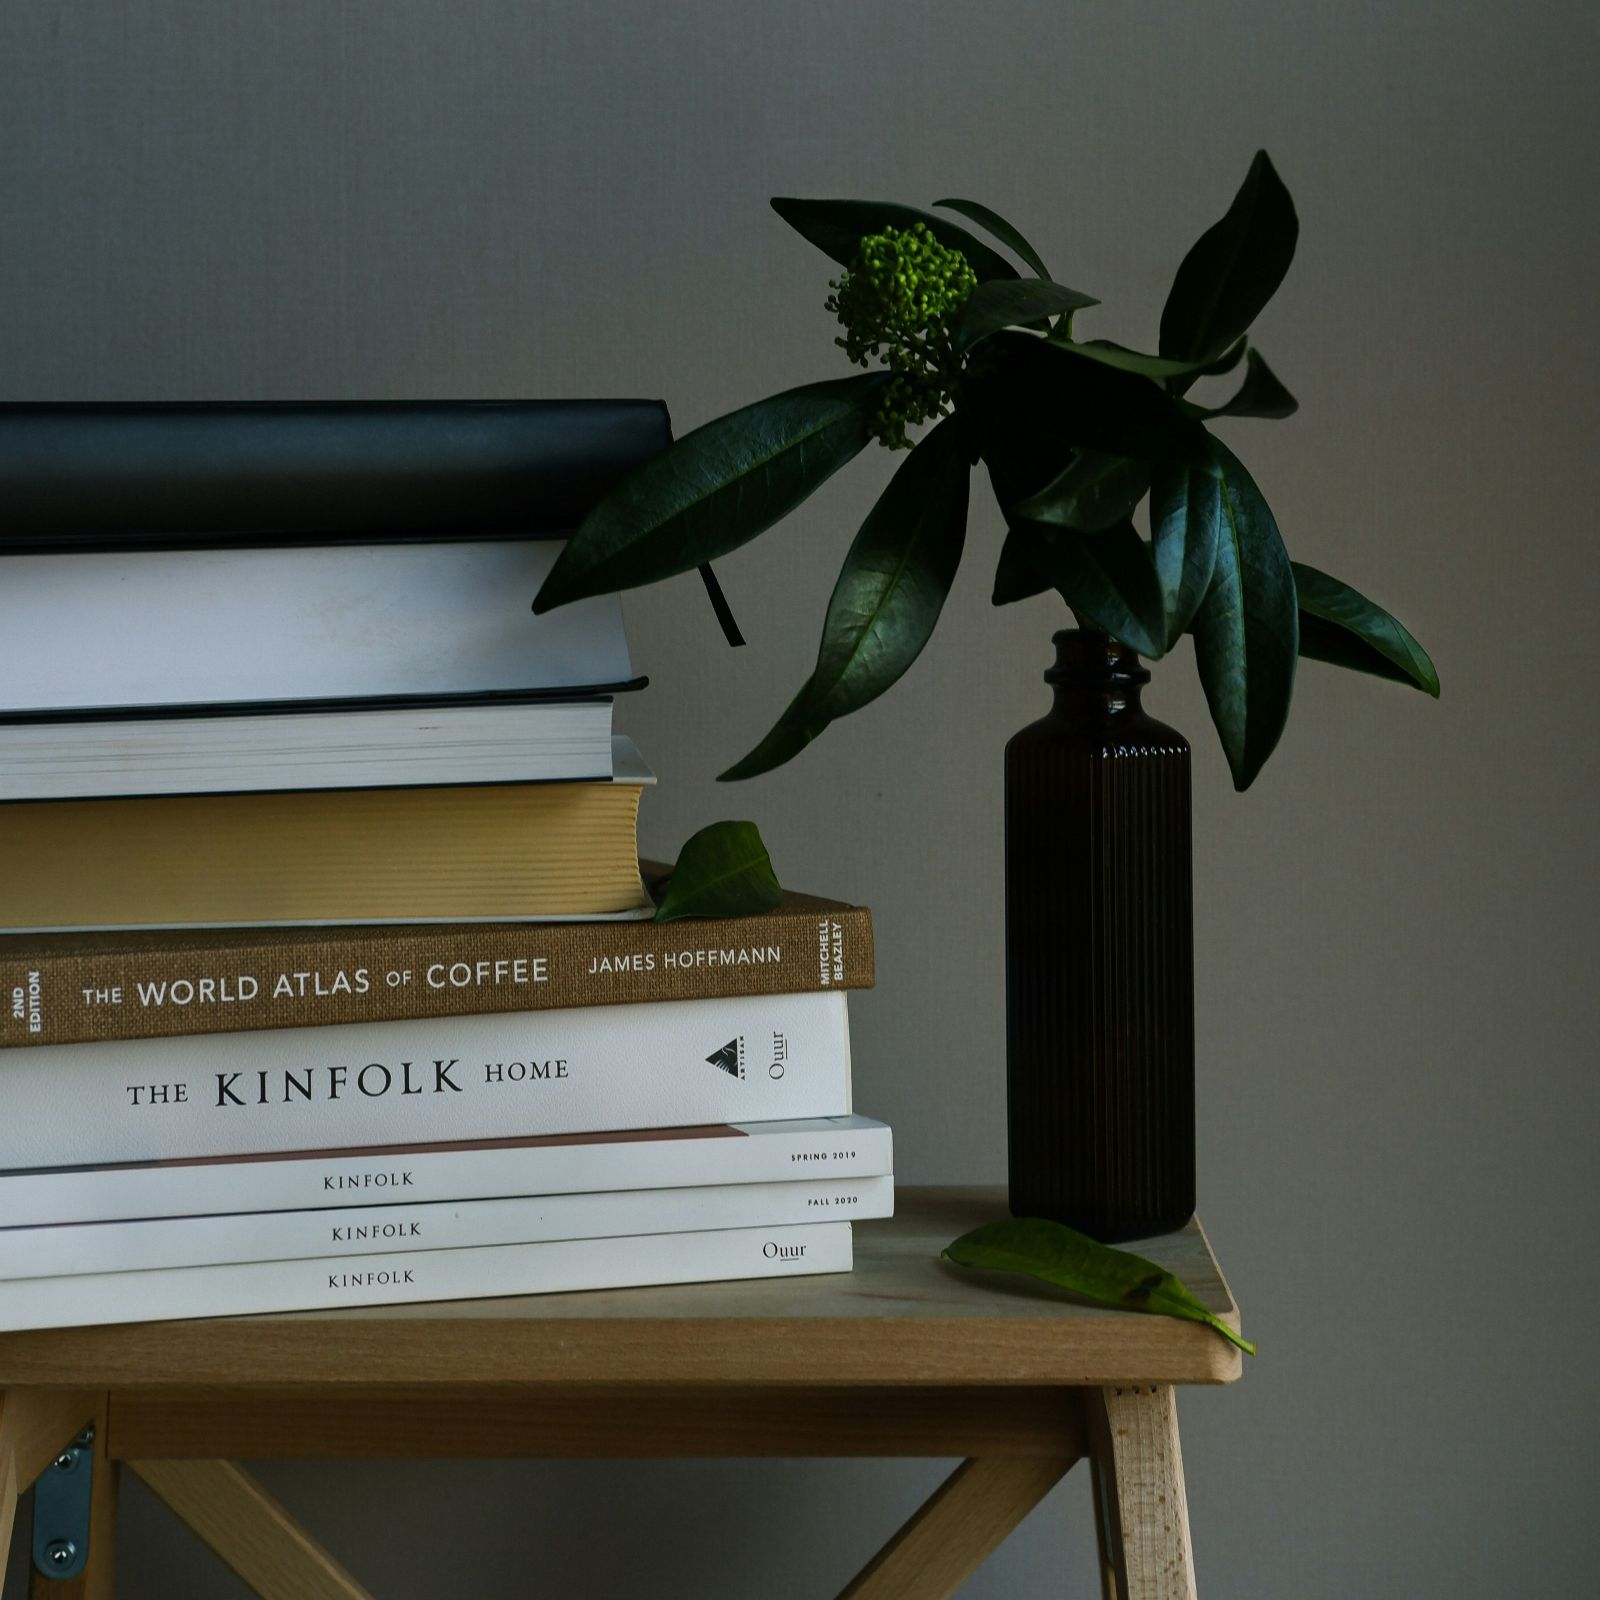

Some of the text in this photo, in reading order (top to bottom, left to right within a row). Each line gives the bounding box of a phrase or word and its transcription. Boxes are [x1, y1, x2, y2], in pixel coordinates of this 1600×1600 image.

[588, 946, 782, 974] JAMES HOFFMANN
[820, 920, 830, 985] MITCHELL
[833, 922, 843, 981] BEAZLEY
[83, 958, 548, 1007] THE WORLD ATLAS OF COFFEE
[13, 987, 25, 1019] 2ND
[29, 971, 40, 1033] EDITION
[768, 1031, 785, 1080] Ouur
[126, 1058, 569, 1106] THE KINFOLK HOME
[791, 1151, 857, 1162] SPRING 2019
[323, 1171, 415, 1190] KINFOLK
[807, 1196, 858, 1206] FALL 2020
[332, 1222, 422, 1241] KINFOLK
[762, 1241, 807, 1259] Ouur
[328, 1269, 415, 1288] KINFOLK
